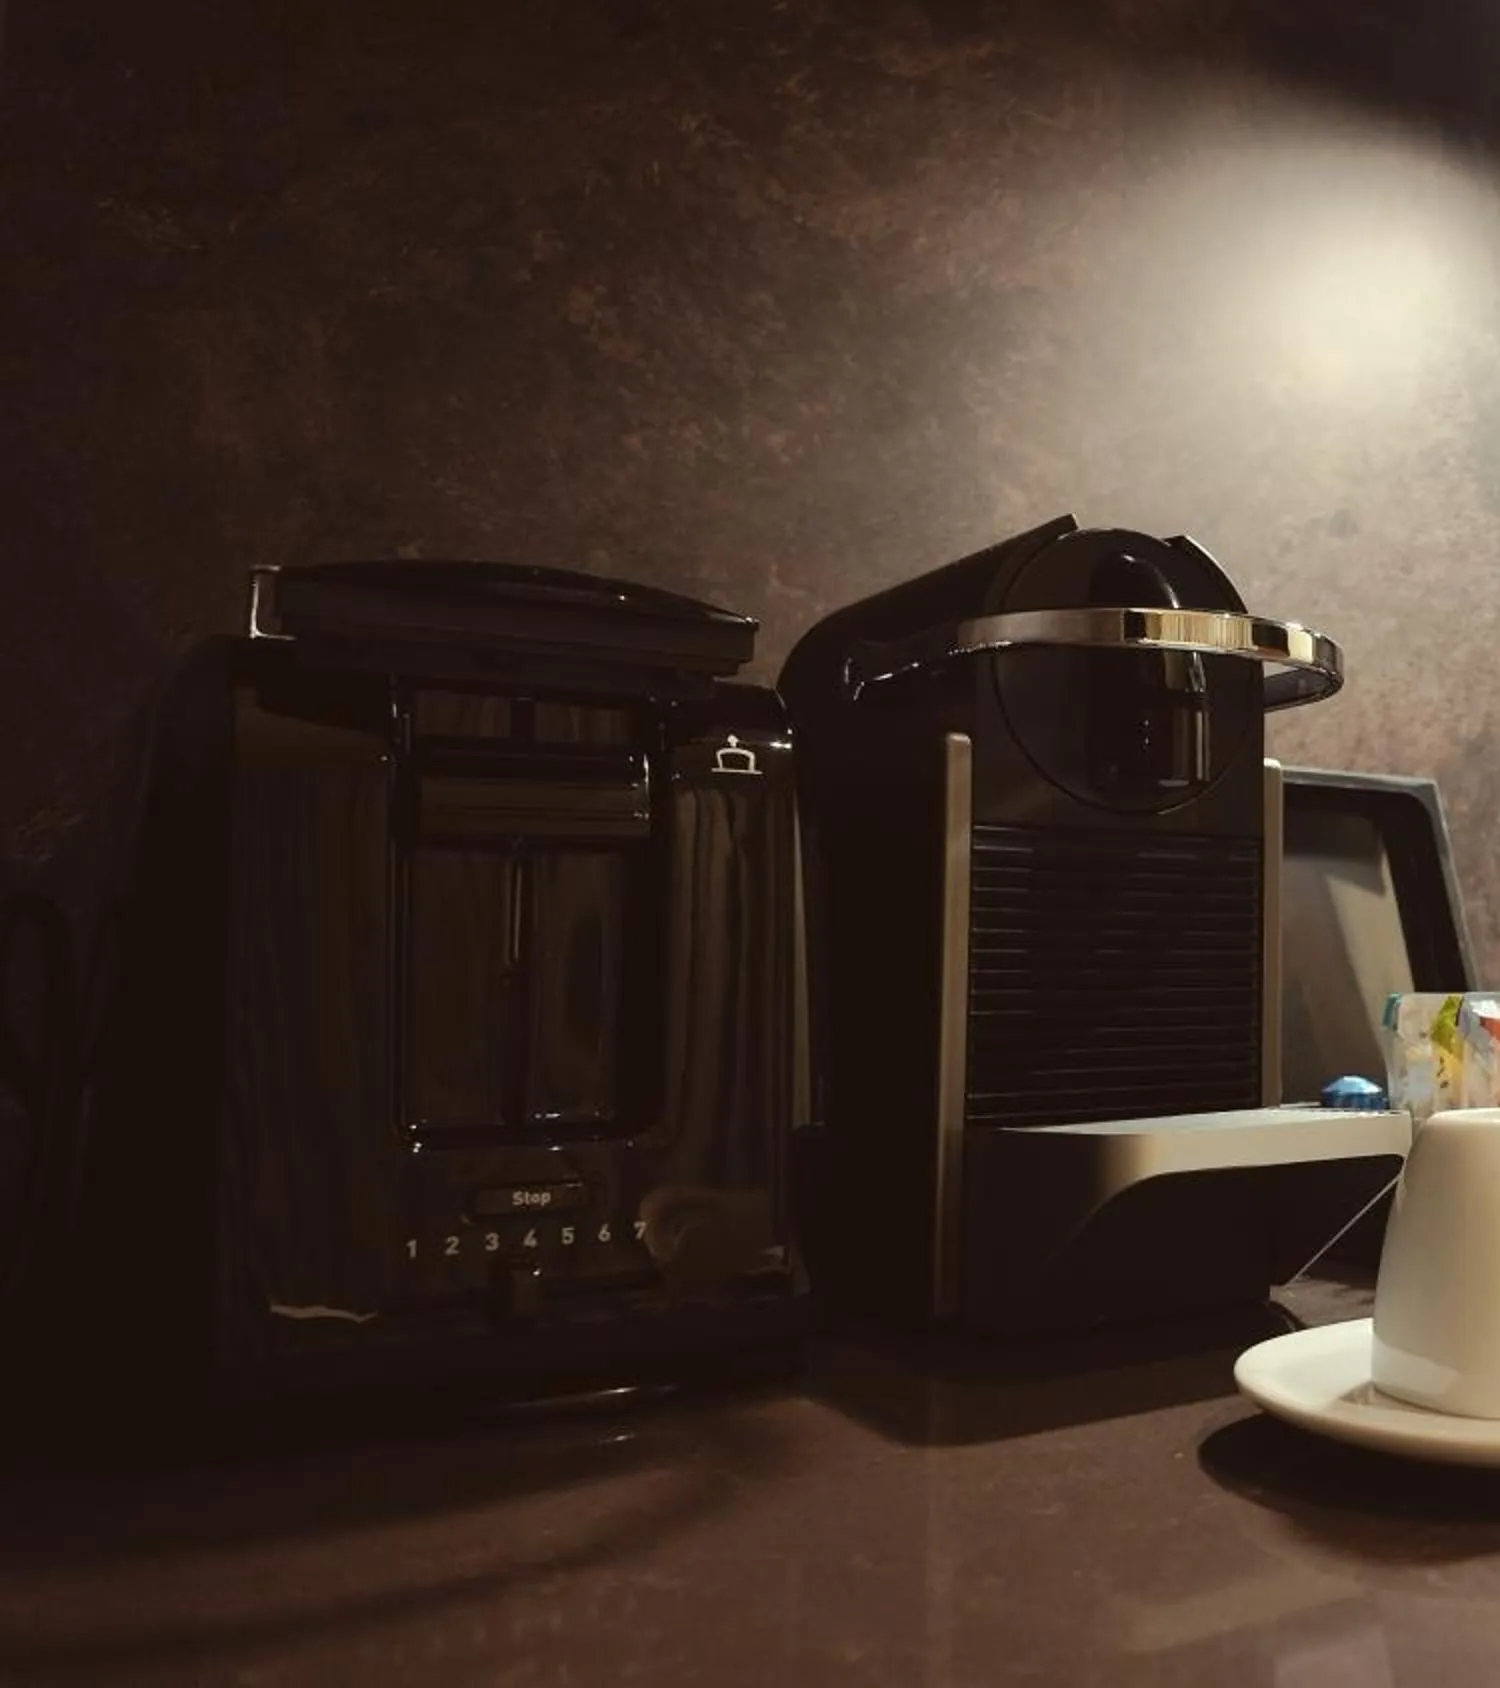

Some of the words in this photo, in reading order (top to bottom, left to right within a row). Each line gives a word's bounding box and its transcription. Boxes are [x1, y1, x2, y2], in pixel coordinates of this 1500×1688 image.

[511, 1190, 552, 1207] Stop
[407, 1239, 418, 1258] 1
[445, 1236, 460, 1255] 2
[485, 1232, 500, 1251] 3
[523, 1229, 538, 1248] 4
[561, 1227, 575, 1245] 5
[598, 1223, 611, 1242] 6
[633, 1220, 648, 1240] 7
